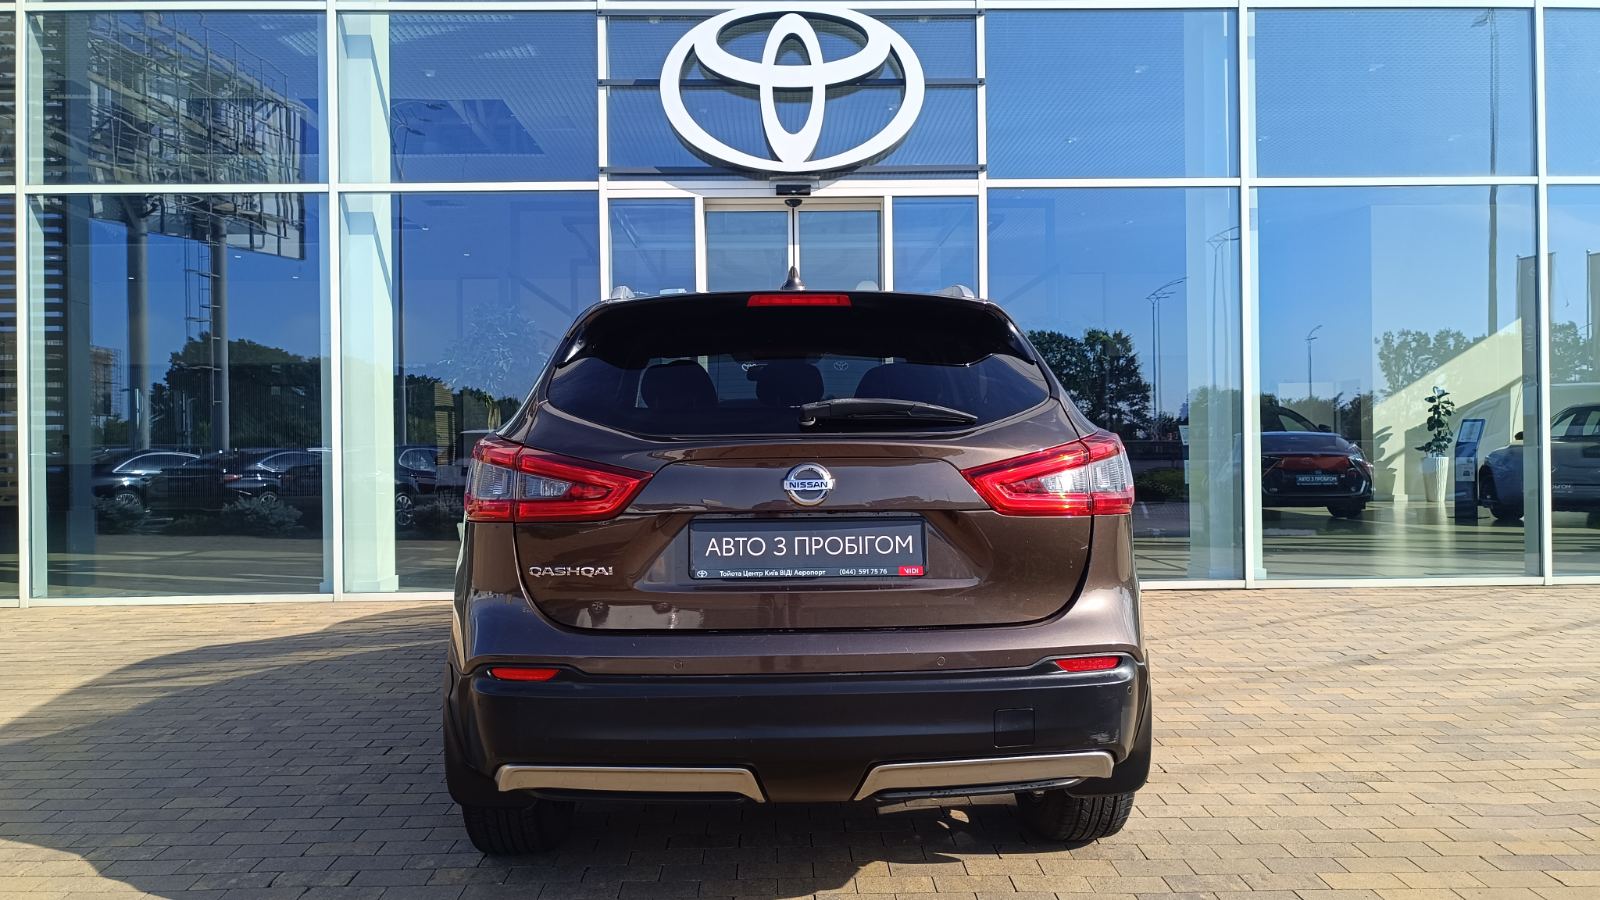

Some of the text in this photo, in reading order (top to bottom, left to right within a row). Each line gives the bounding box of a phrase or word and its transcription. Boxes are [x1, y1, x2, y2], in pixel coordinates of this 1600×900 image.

[788, 480, 829, 491] NISSAN
[705, 537, 766, 557] АВТО
[794, 535, 914, 556] ПРОБІГОМ
[529, 566, 614, 577] QASHQAI
[793, 569, 826, 577] Аеропорт
[839, 568, 857, 576] (044)
[904, 567, 919, 575] VIDI
